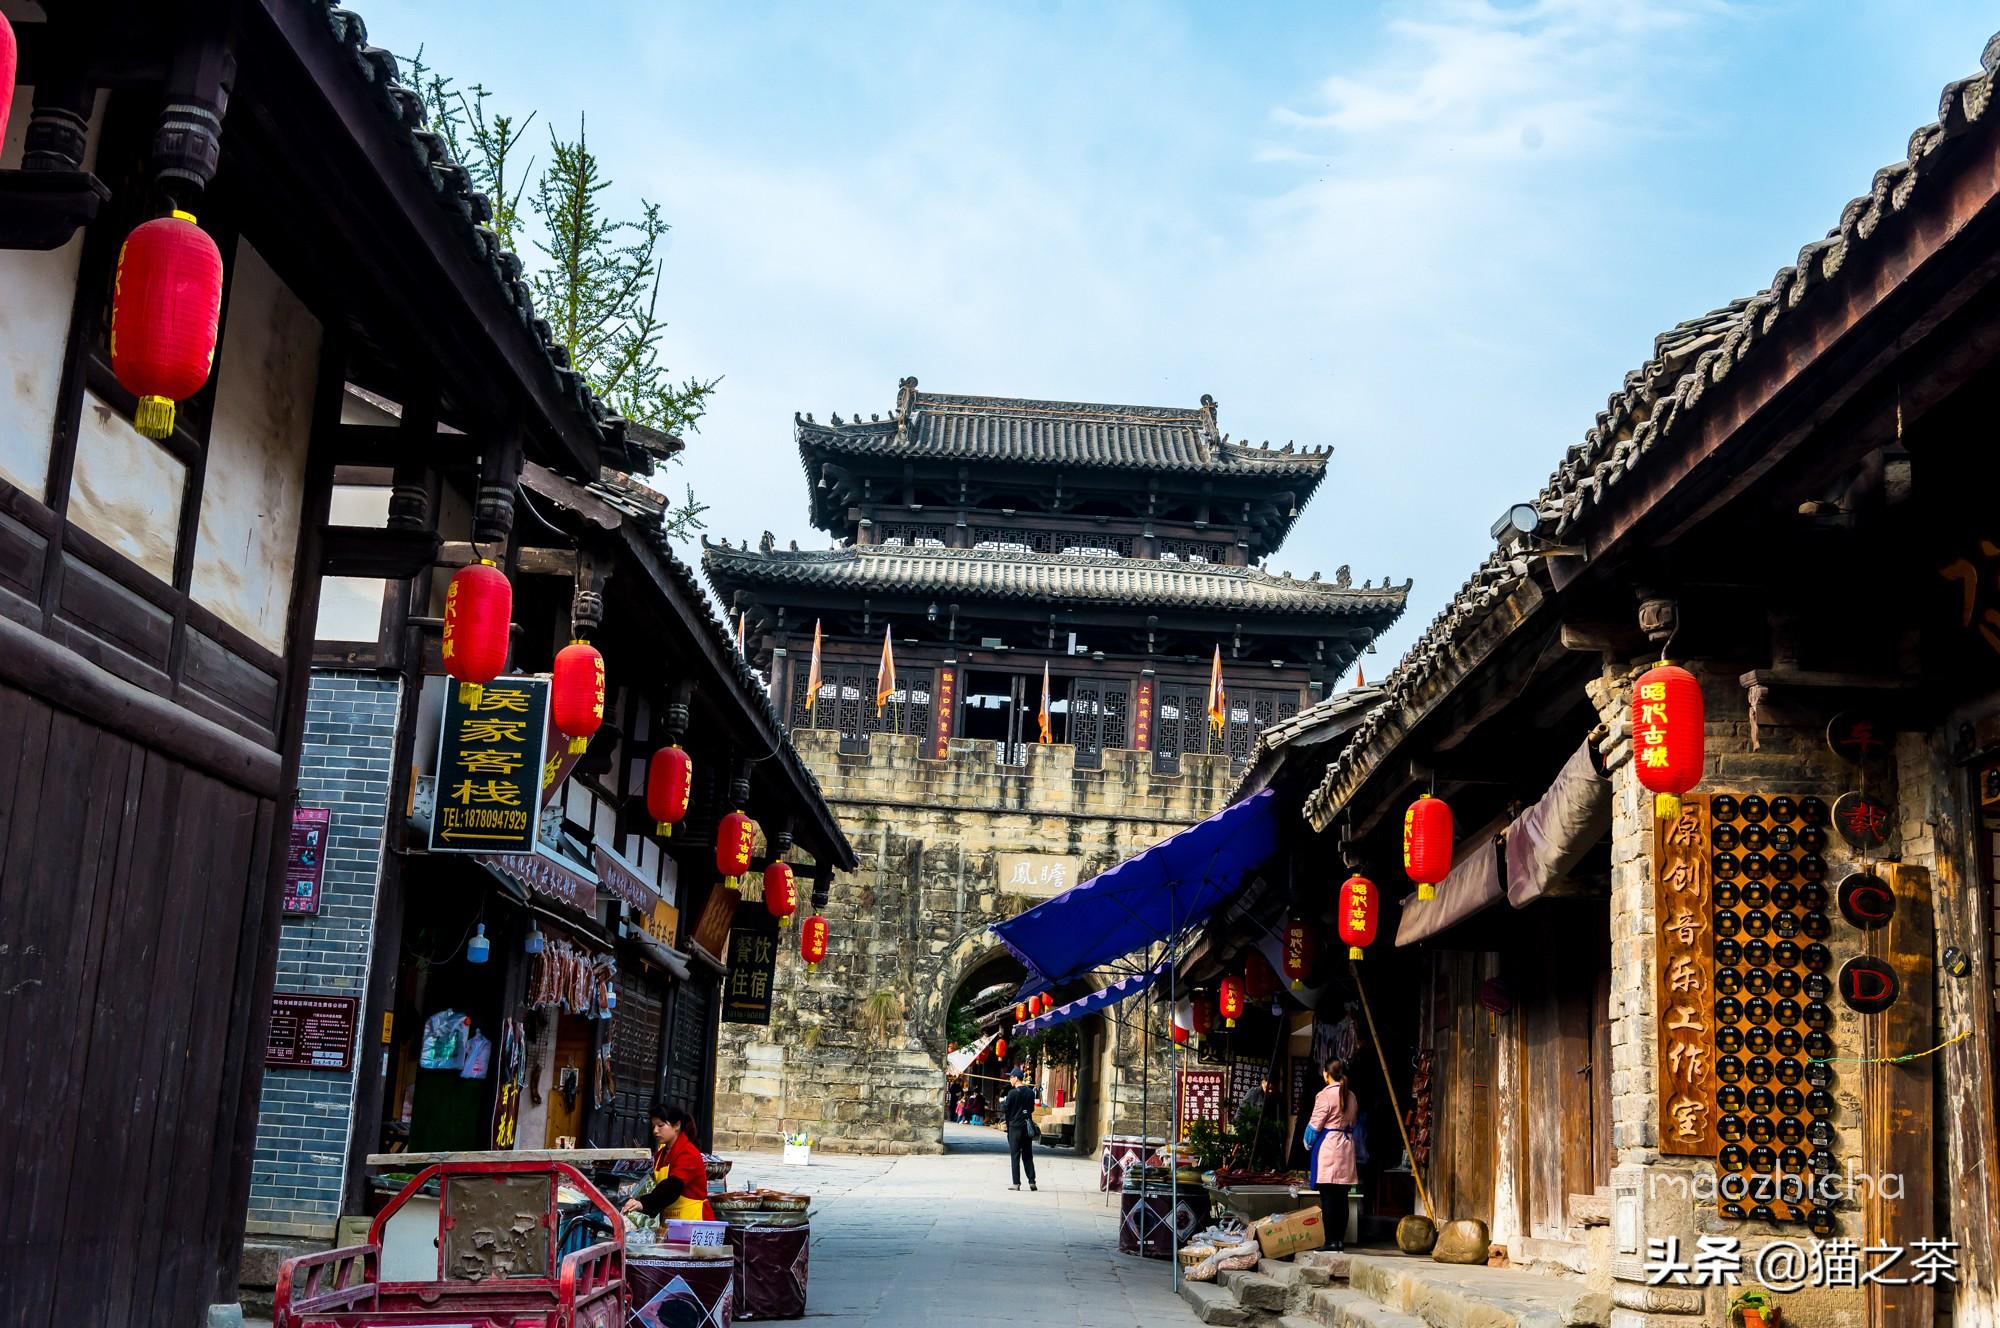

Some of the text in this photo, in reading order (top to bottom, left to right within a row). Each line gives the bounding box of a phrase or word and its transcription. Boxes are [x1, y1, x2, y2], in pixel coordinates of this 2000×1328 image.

[1641, 682, 1669, 768] 昭化古城
[442, 807, 527, 830] TEL:18780947929
[736, 821, 752, 865] 昭化古城
[1350, 883, 1368, 932] 昭化古城
[736, 935, 772, 964] 餐饮
[811, 922, 824, 956] 昭化古城
[731, 968, 768, 999] 住宿
[1663, 802, 1704, 1137] 原创音乐工作室
